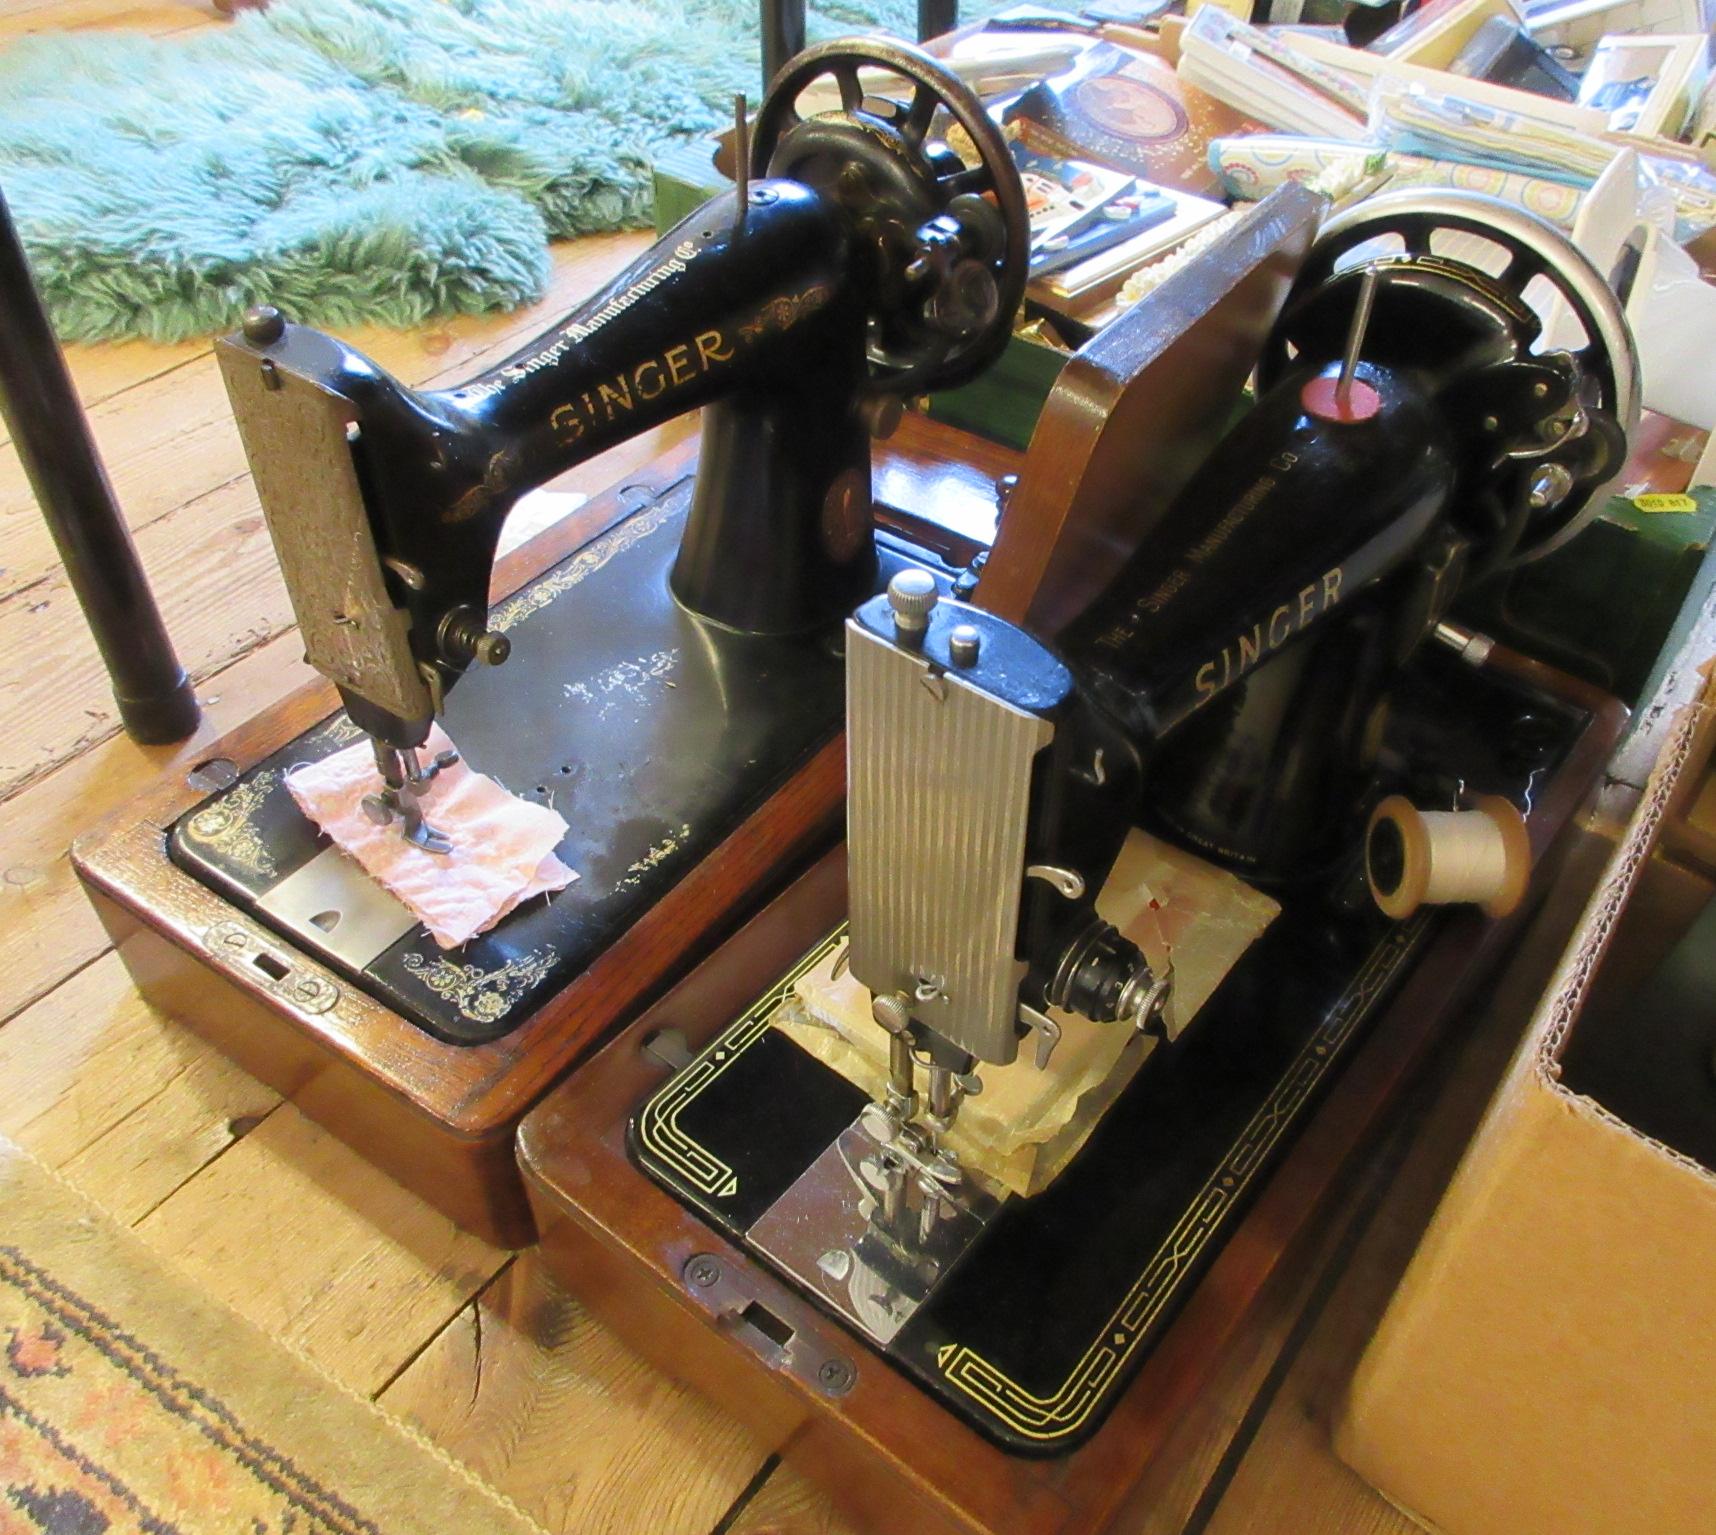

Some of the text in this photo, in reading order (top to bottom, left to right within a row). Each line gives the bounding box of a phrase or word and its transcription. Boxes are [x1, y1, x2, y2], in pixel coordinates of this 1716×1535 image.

[501, 339, 571, 385] Singer
[560, 259, 687, 343] Manufacturing
[550, 330, 734, 446] SINGER
[1195, 567, 1343, 697] SINGER
